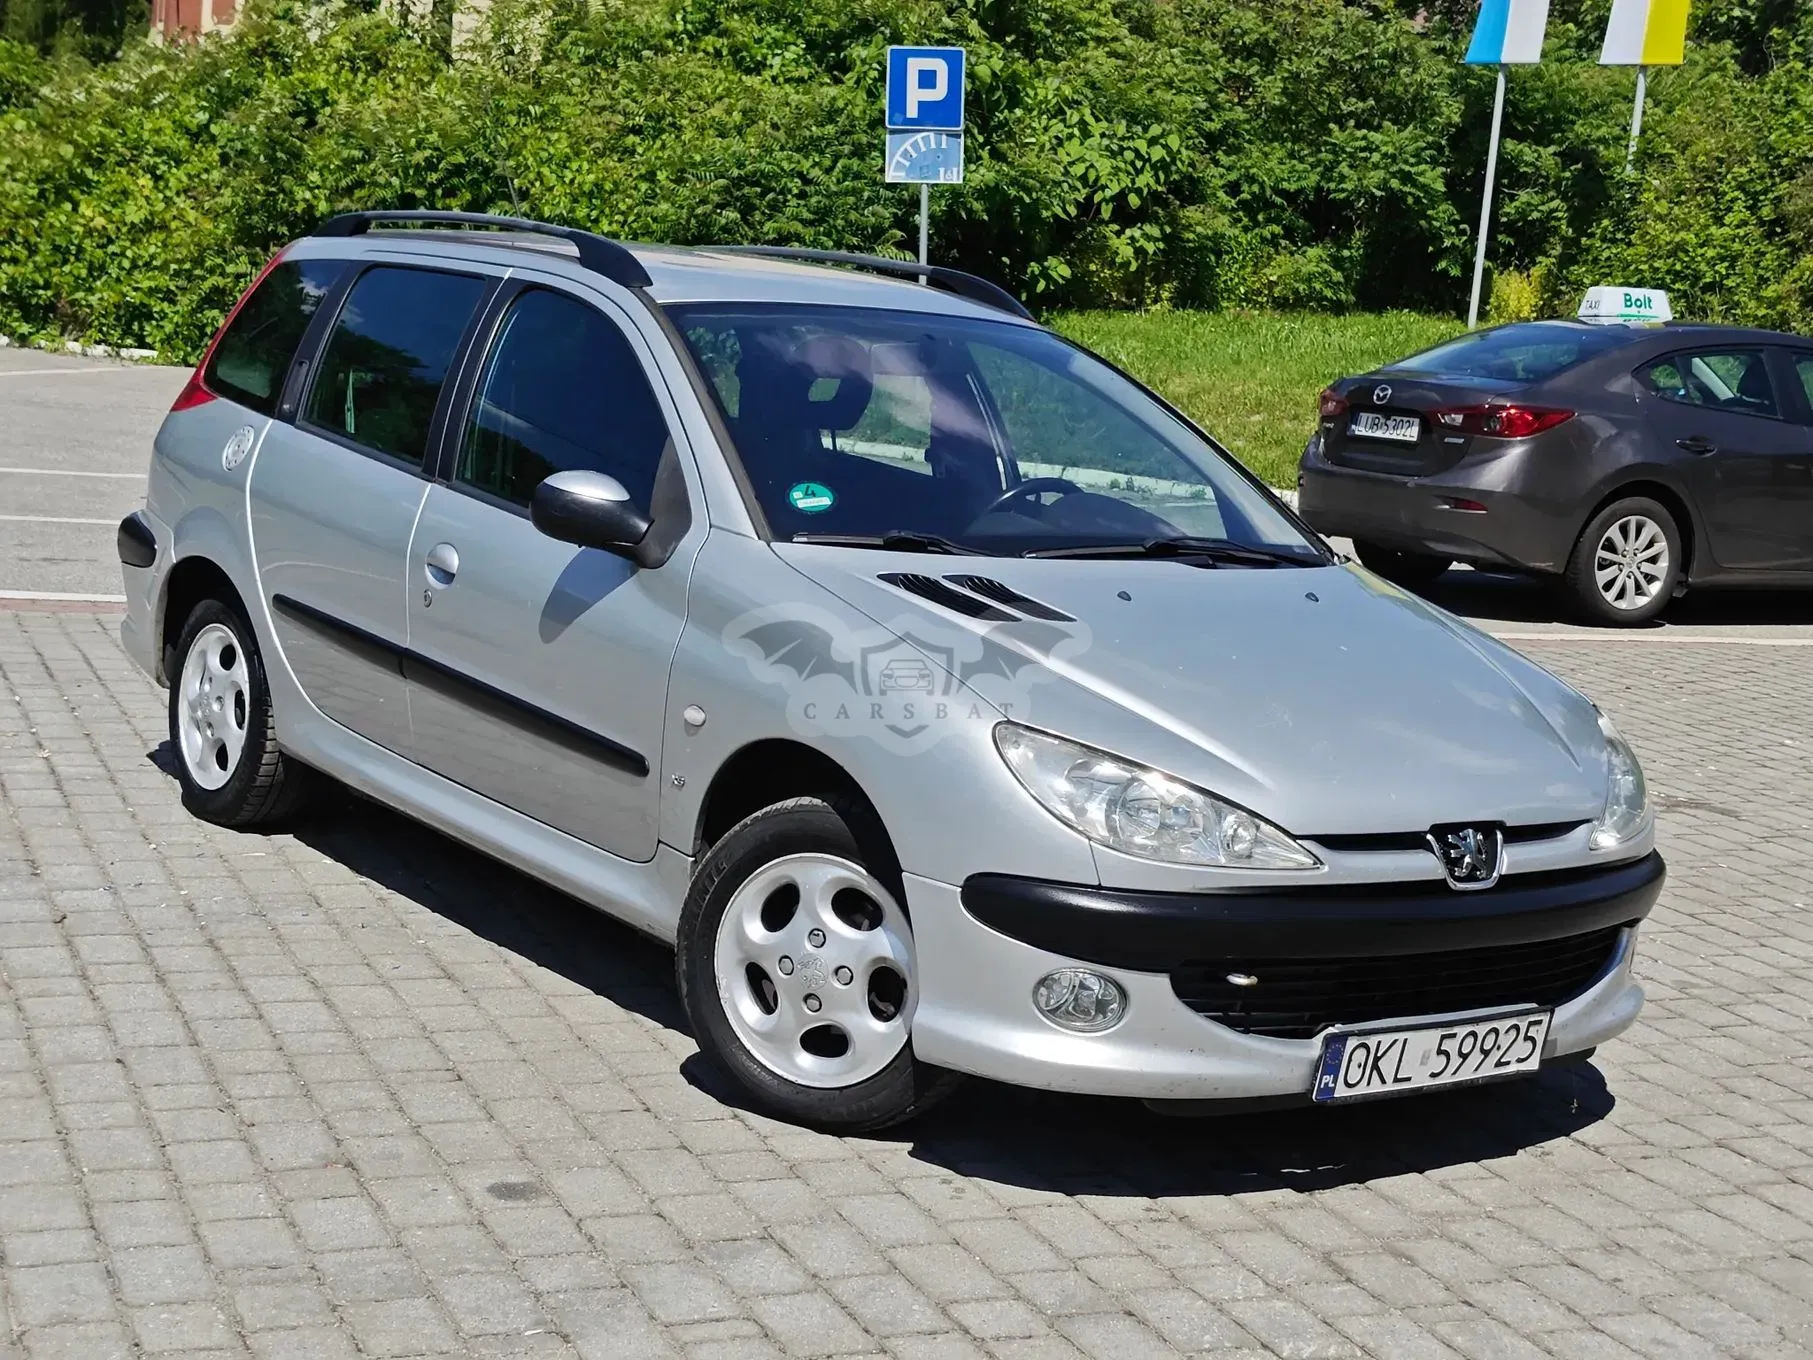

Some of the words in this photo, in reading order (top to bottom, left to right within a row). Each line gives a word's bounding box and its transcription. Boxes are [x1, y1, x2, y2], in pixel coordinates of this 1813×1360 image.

[906, 57, 948, 119] P
[1585, 300, 1600, 310] TAXI
[1623, 293, 1653, 310] Bolt
[1357, 415, 1380, 433] LUB
[1382, 416, 1416, 438] 5302L
[804, 485, 816, 497] 4
[1343, 1037, 1412, 1088] OKL
[1429, 1019, 1544, 1079] 59925
[1320, 1074, 1335, 1089] PL
